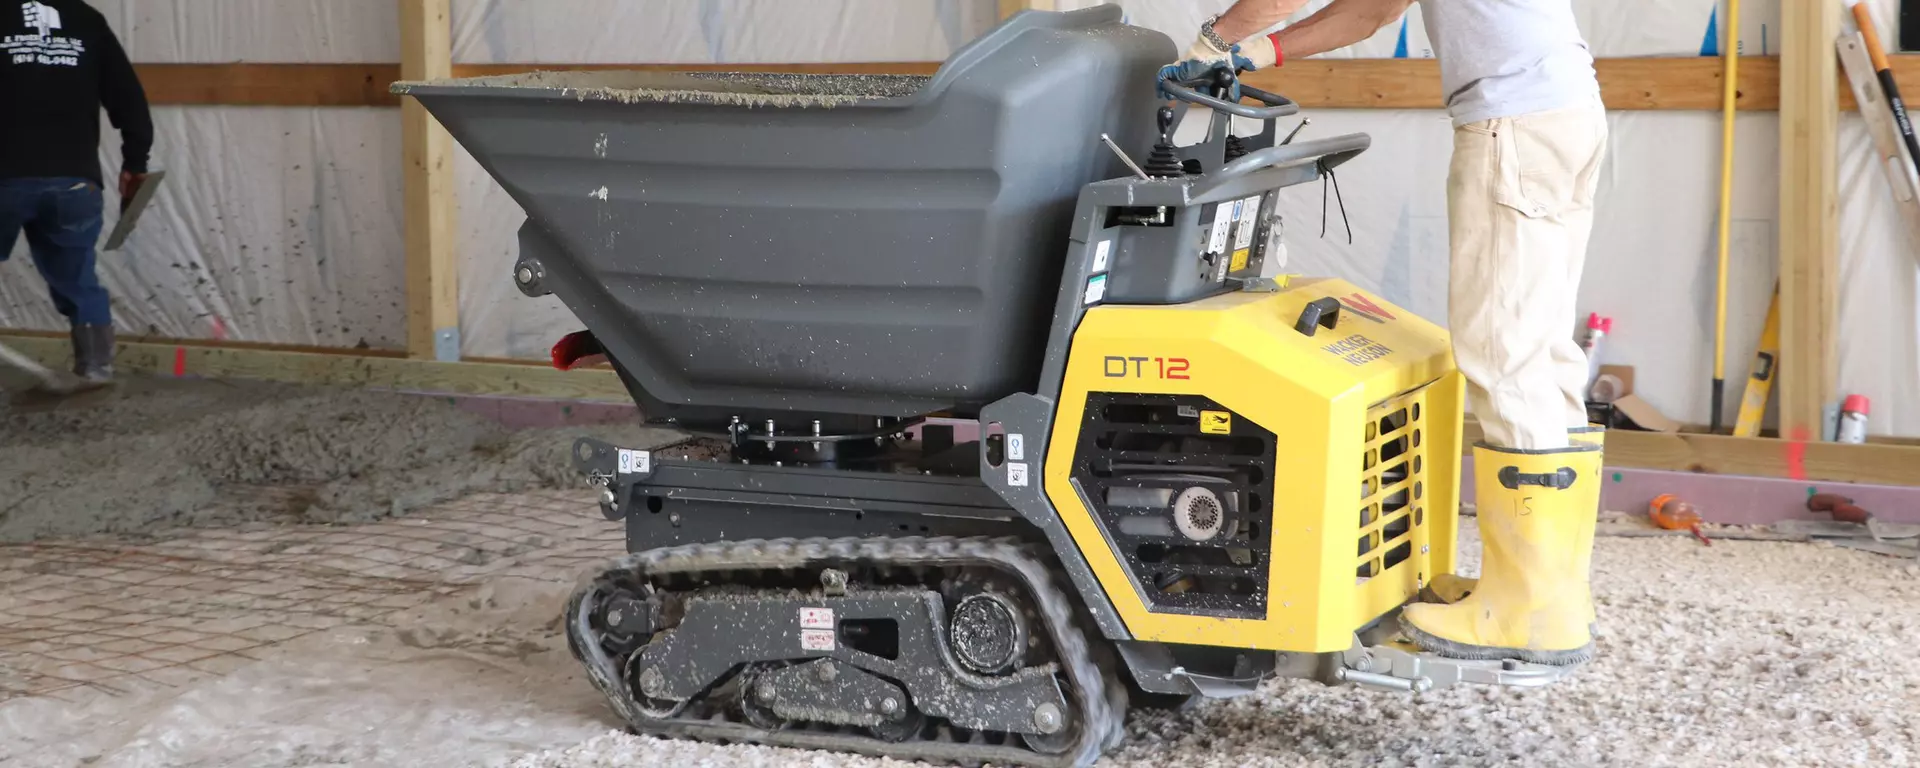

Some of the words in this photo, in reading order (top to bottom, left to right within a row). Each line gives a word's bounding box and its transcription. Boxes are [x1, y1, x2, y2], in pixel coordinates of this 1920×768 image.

[1320, 333, 1376, 356] WACKER
[1341, 342, 1395, 367] NEUSON
[1513, 496, 1533, 518] 15
